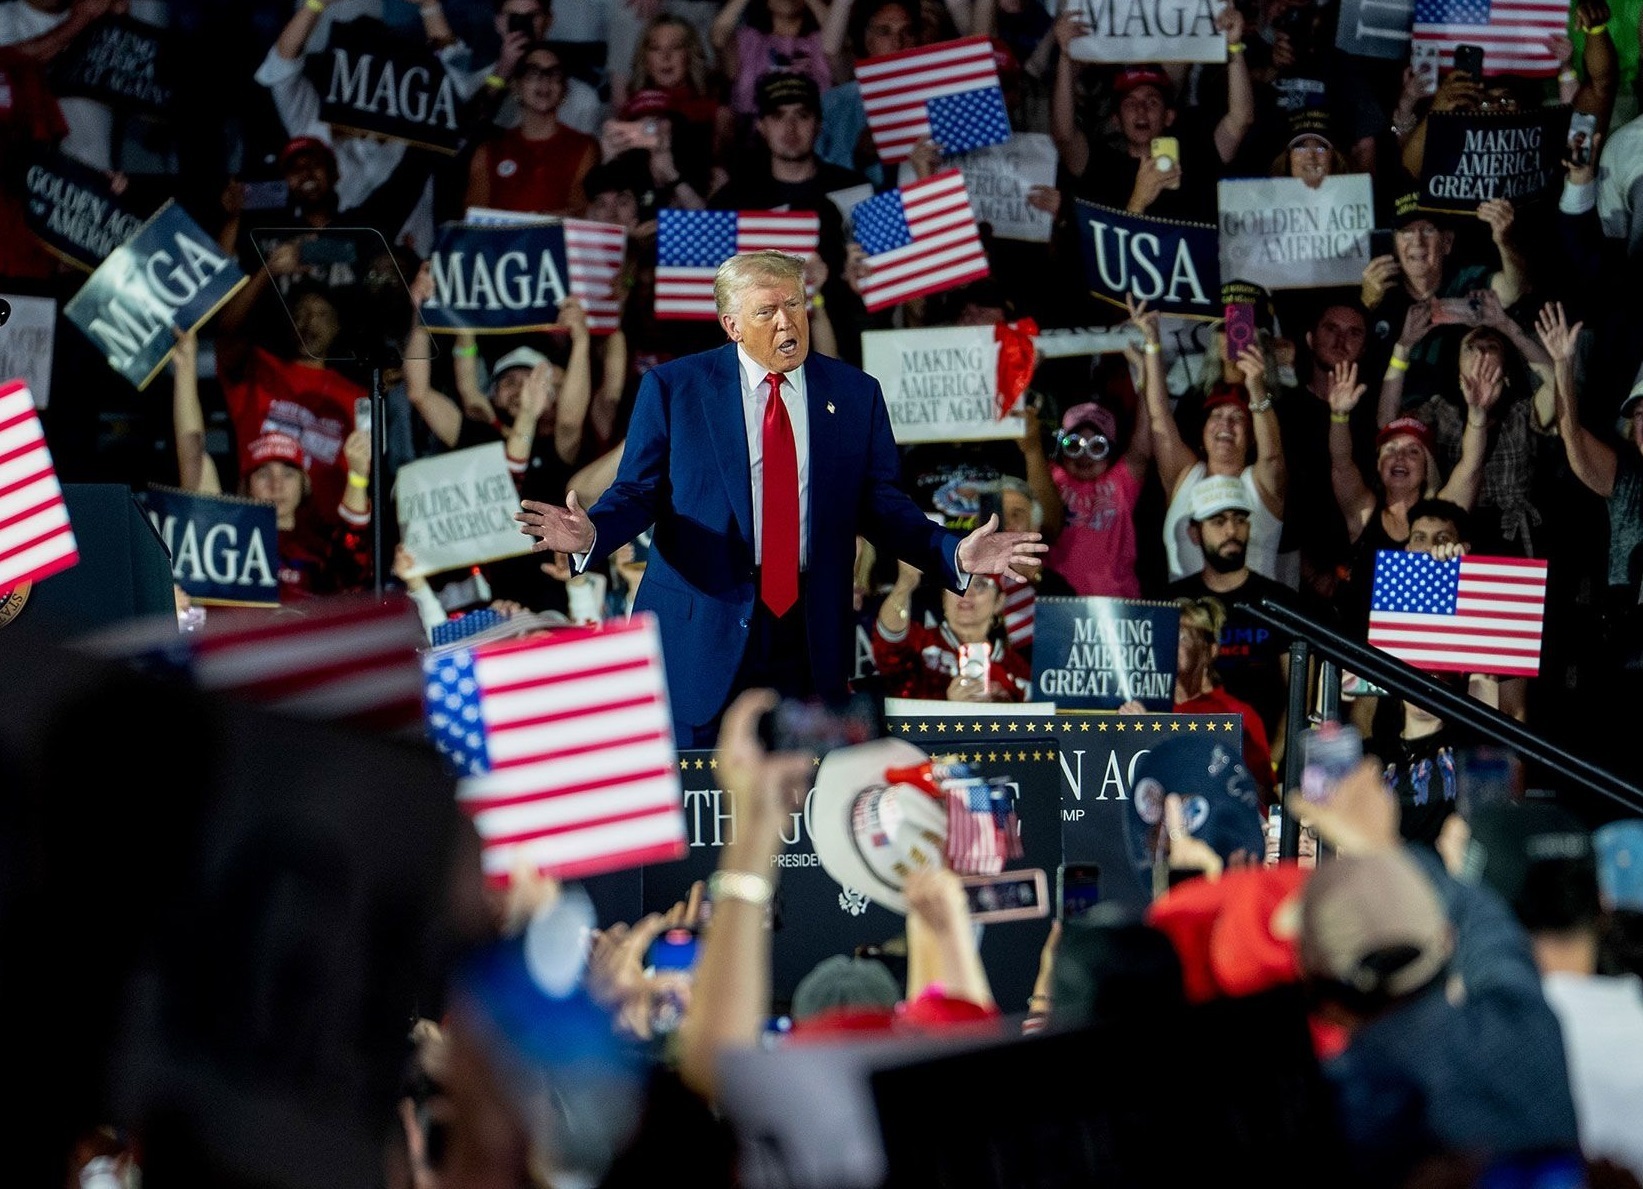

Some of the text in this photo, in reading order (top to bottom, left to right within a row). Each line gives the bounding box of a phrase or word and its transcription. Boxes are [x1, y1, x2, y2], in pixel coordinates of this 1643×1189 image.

[326, 47, 458, 130] MAGA
[1464, 126, 1542, 153] MAKING
[1454, 151, 1540, 177] AMERICA
[1428, 174, 1500, 200] GREAT
[1223, 206, 1320, 238] GOLDEN
[1326, 202, 1370, 232] AGE
[1260, 232, 1364, 263] AMERICA
[1088, 219, 1212, 305] USA
[422, 249, 568, 310] MAGA
[88, 231, 230, 370] MAGA
[901, 347, 983, 373] MAKING
[897, 372, 991, 399] AMERICA
[889, 400, 940, 425] REAT
[1065, 644, 1157, 672] AMERICA
[1039, 668, 1113, 697] GREAT
